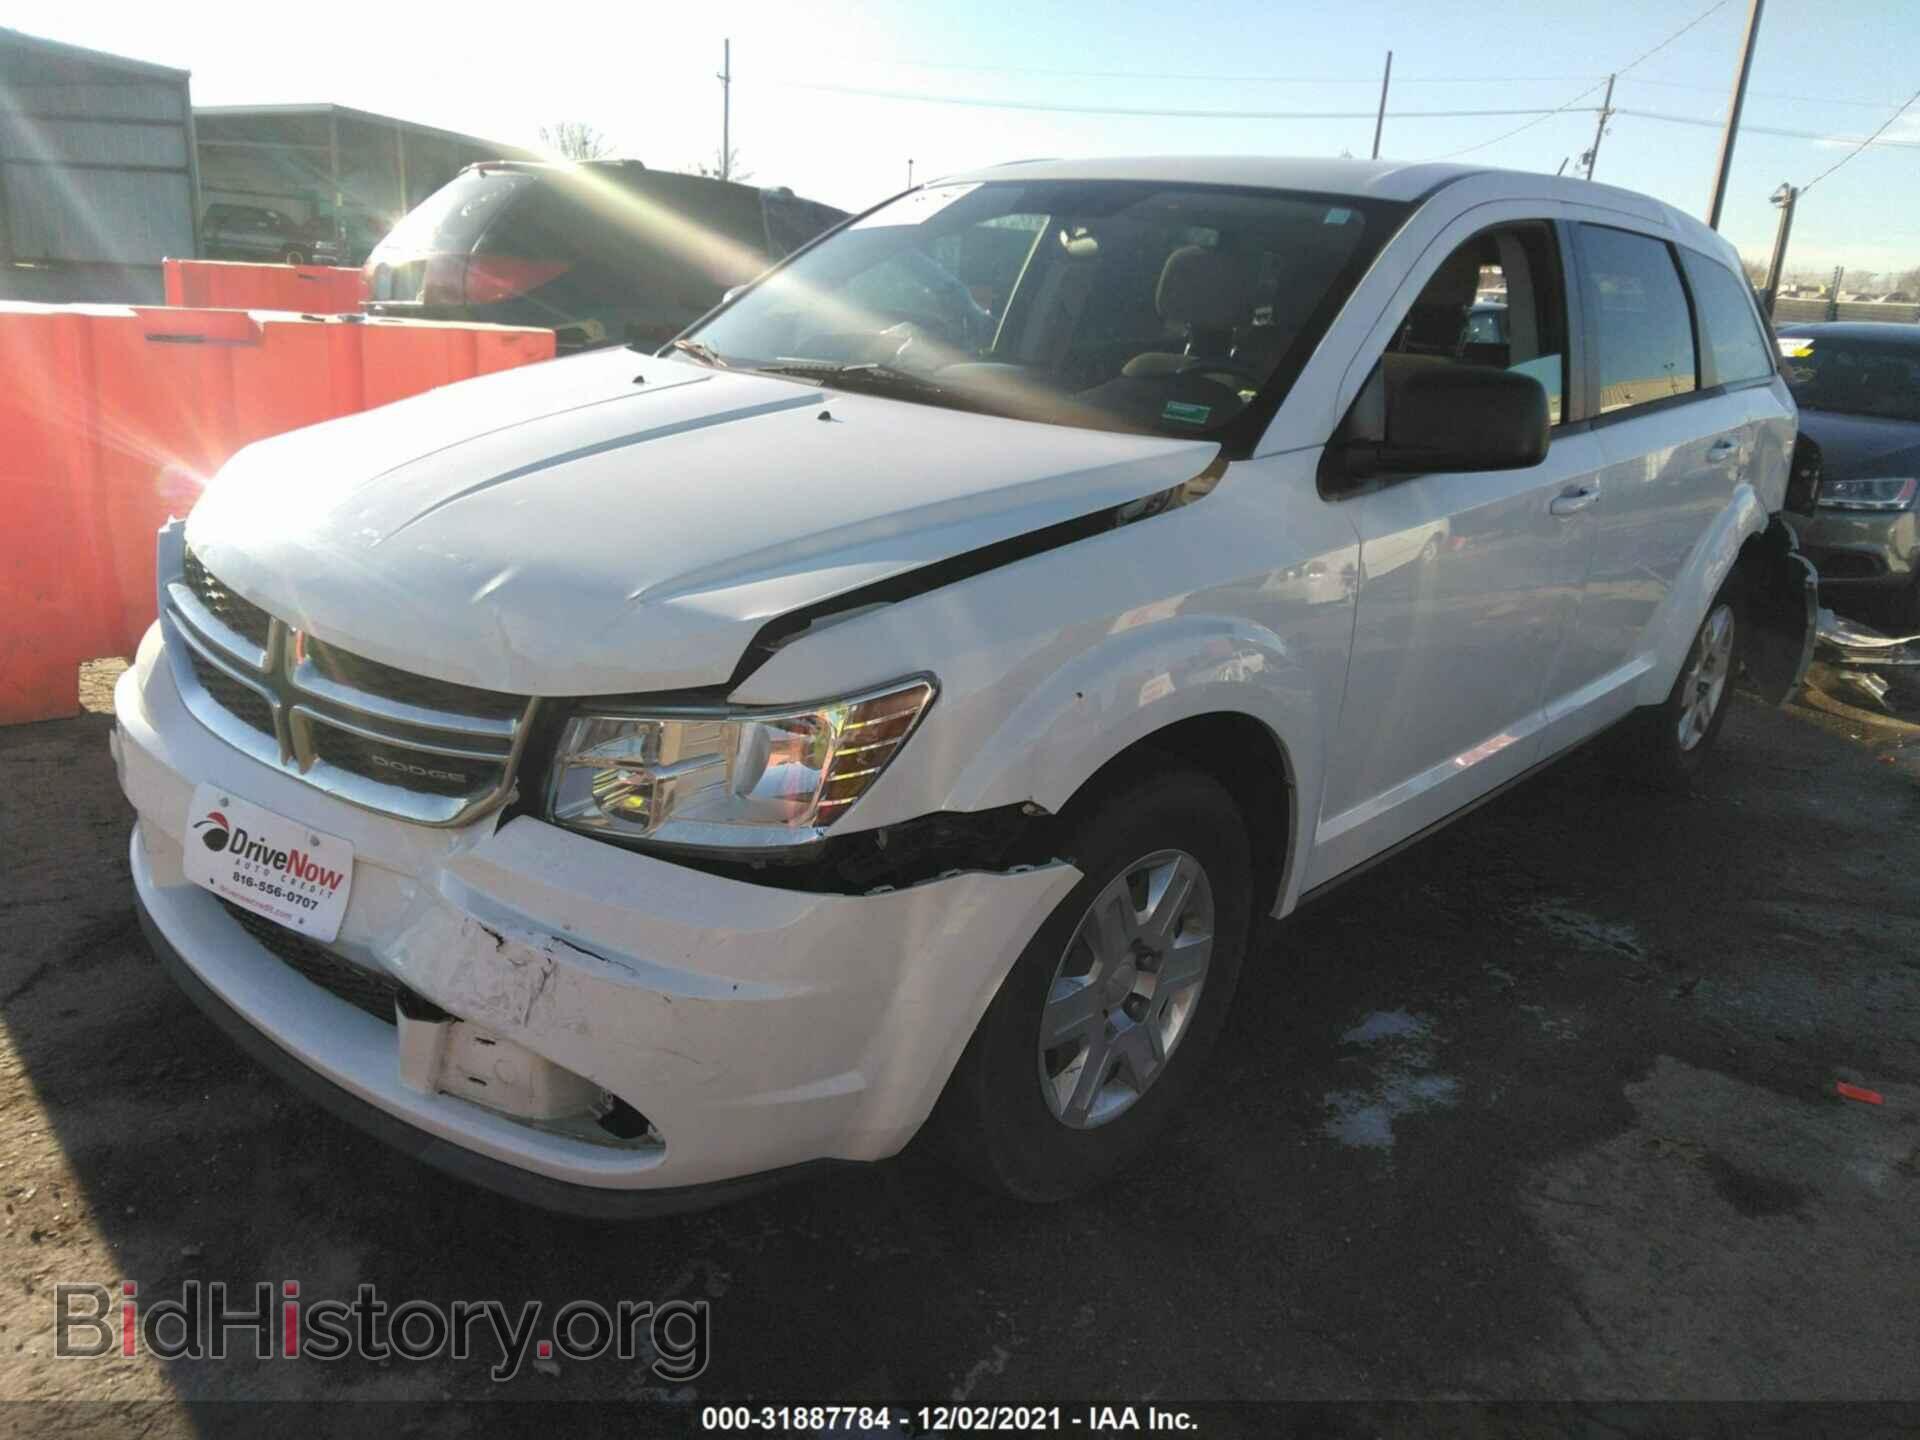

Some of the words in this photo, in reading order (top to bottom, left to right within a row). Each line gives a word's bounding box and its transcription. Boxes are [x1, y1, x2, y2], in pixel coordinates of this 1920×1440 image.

[372, 755, 467, 783] DODGE
[229, 828, 344, 891] DriveNow
[234, 858, 270, 876] AUTO
[281, 875, 333, 899] CREDIT
[232, 872, 319, 911] 816-556-0707
